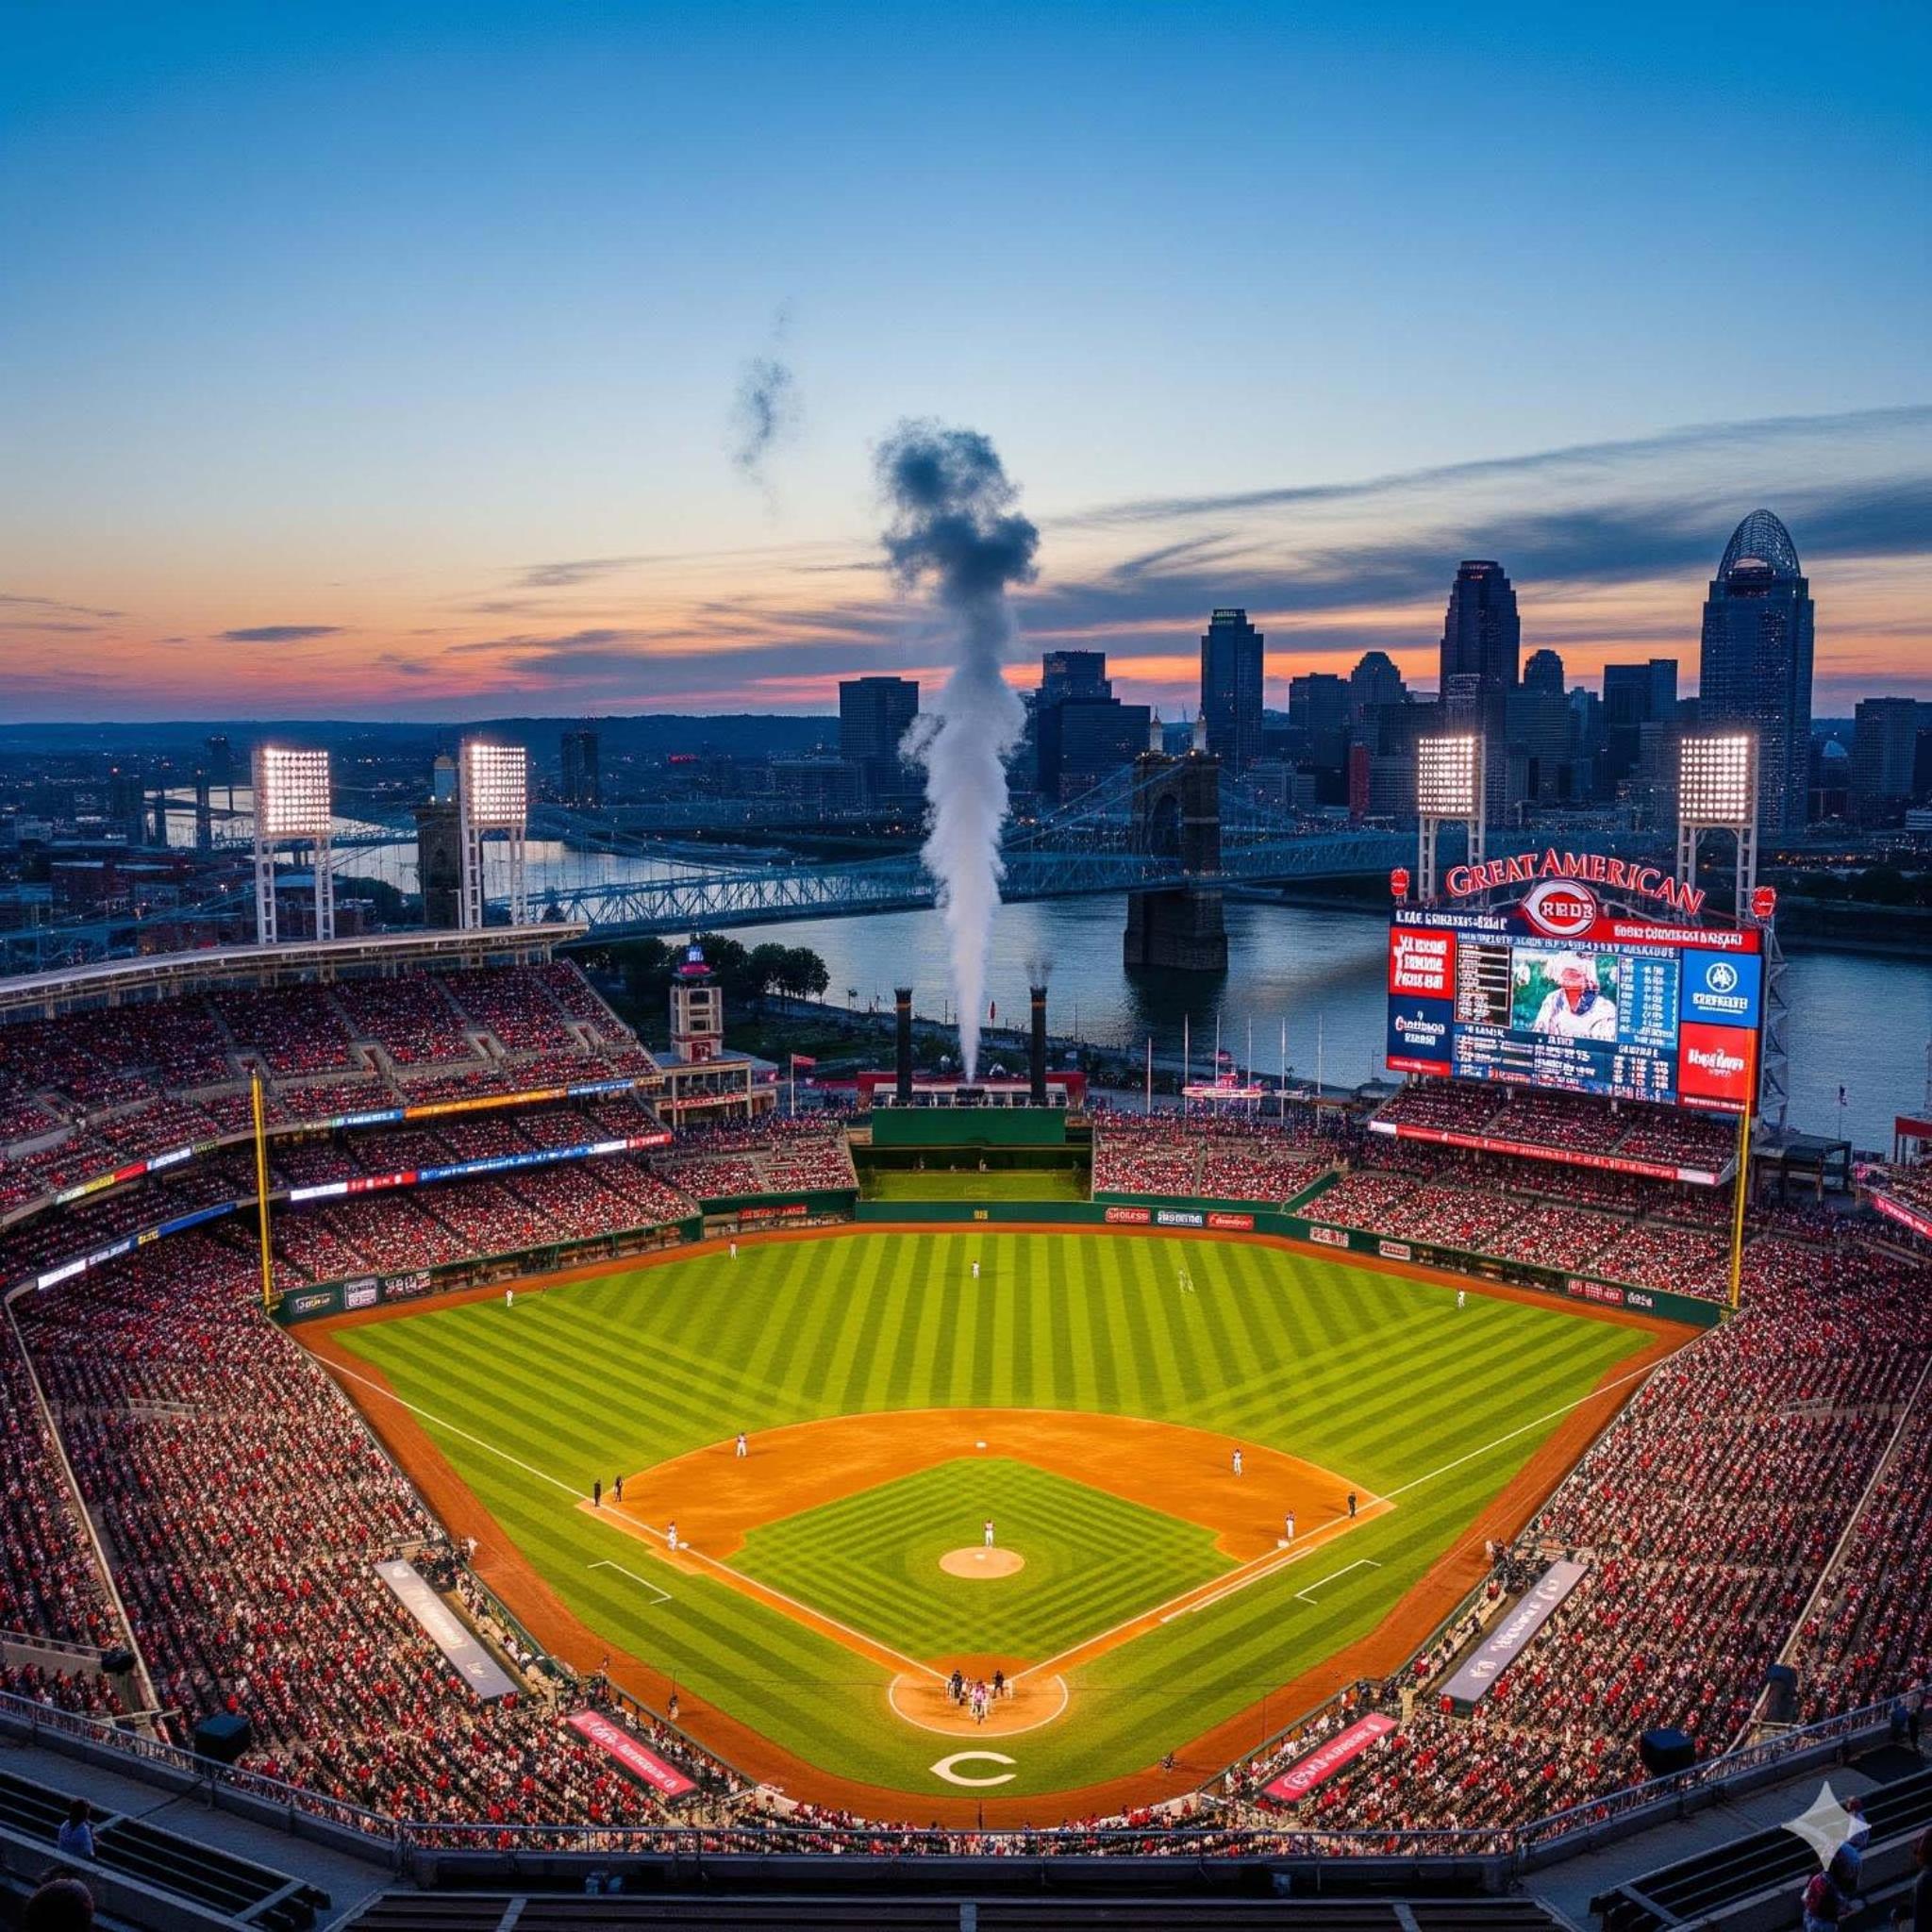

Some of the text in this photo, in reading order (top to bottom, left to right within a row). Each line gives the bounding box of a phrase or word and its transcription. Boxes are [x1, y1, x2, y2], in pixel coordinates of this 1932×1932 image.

[1445, 847, 1706, 915] GREAT AMERICAN
[928, 1751, 1018, 1787] C
